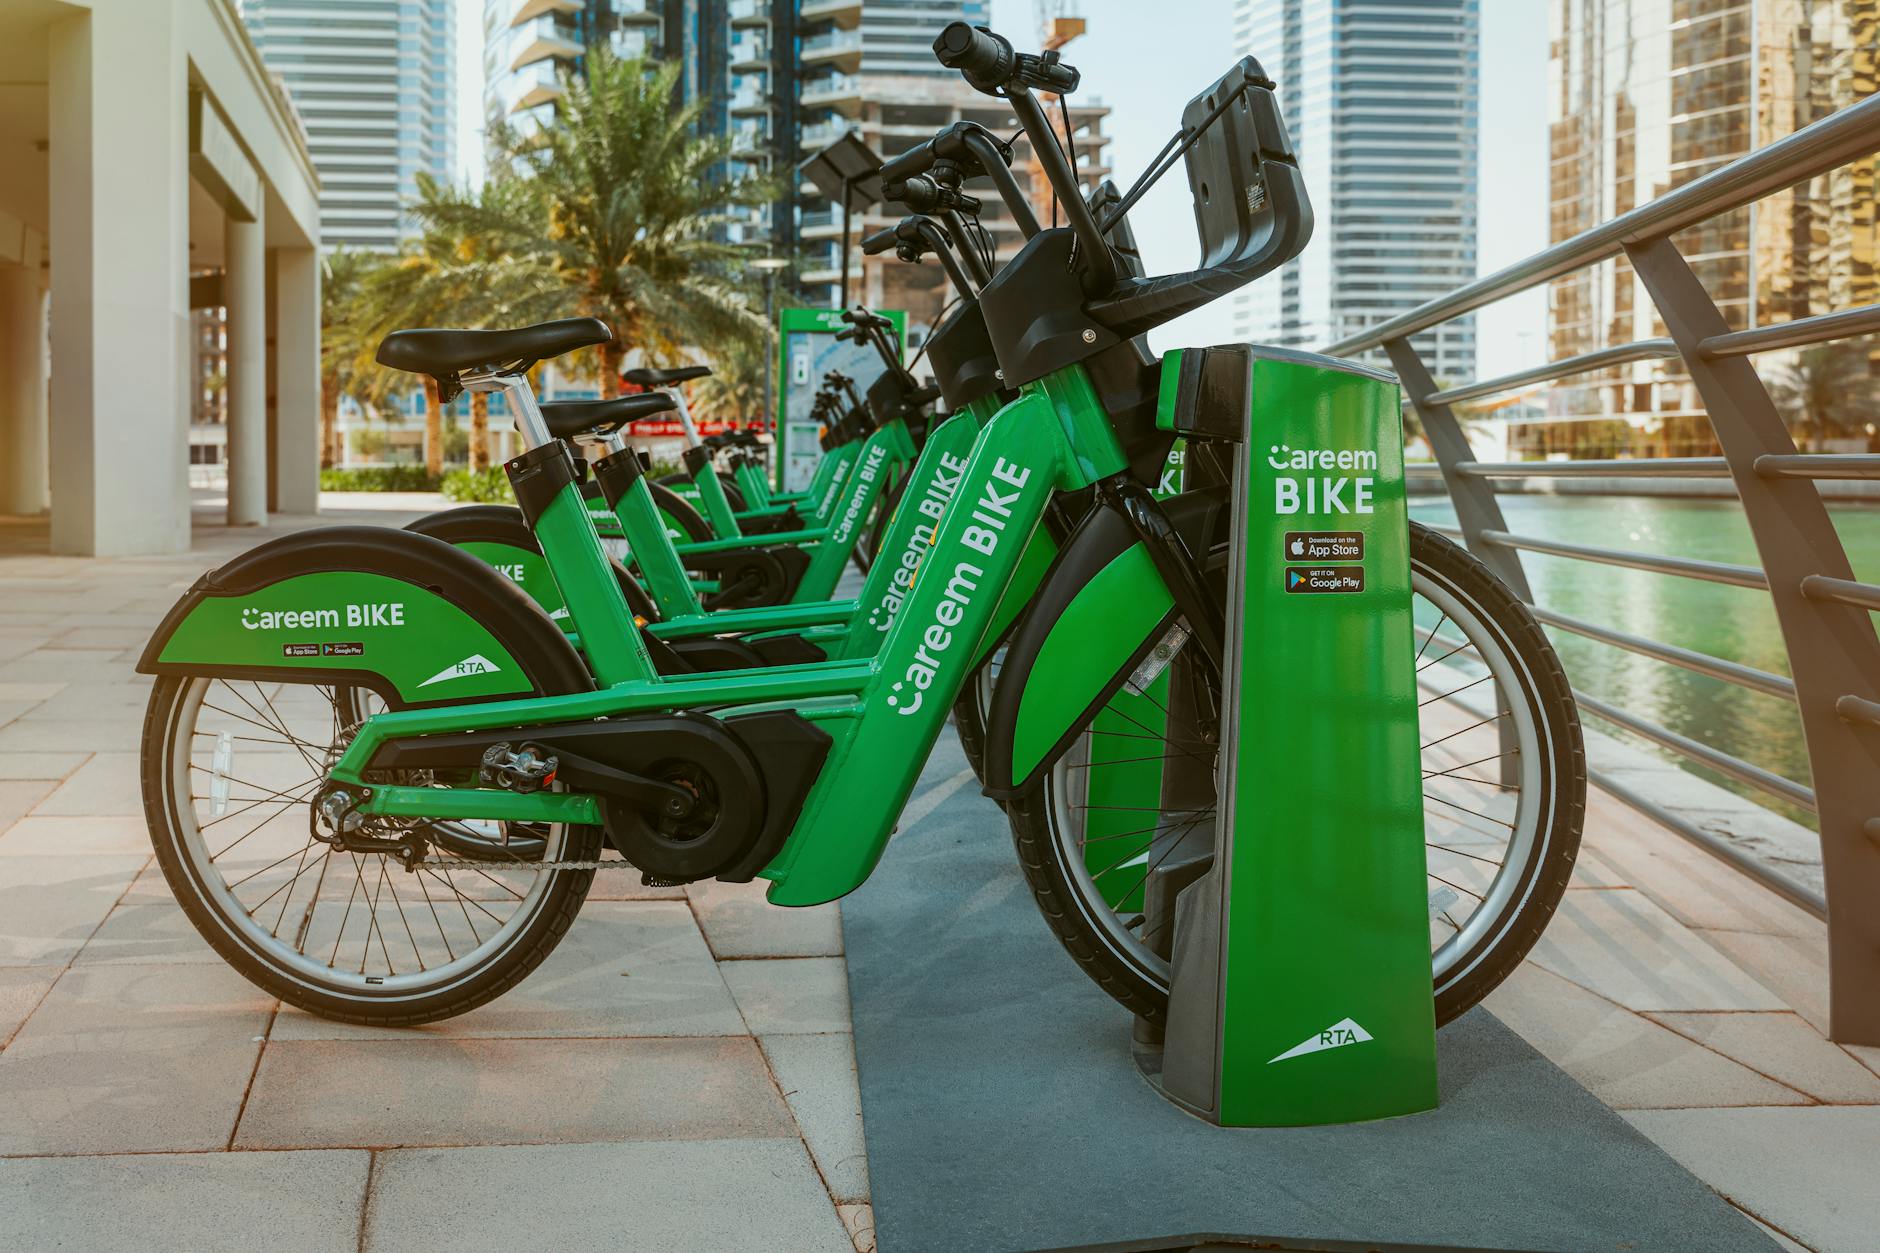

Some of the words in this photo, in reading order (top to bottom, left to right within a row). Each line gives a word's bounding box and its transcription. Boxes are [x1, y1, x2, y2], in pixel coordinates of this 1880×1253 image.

[1268, 445, 1377, 470] Careem
[833, 483, 870, 543] Careem
[859, 444, 887, 483] BIKE
[1275, 477, 1374, 515] BIKE
[869, 524, 935, 632] Careem
[918, 451, 968, 521] BIKE
[1308, 544, 1330, 557] App
[1332, 544, 1359, 555] Store
[887, 562, 984, 716] Careem
[960, 457, 1031, 556] BIKE
[1310, 577, 1342, 589] Google
[1342, 577, 1360, 589] Play
[241, 607, 339, 630] Careem
[346, 603, 405, 627] BIKE
[456, 662, 487, 674] RTA
[1320, 1029, 1358, 1045] RTA
